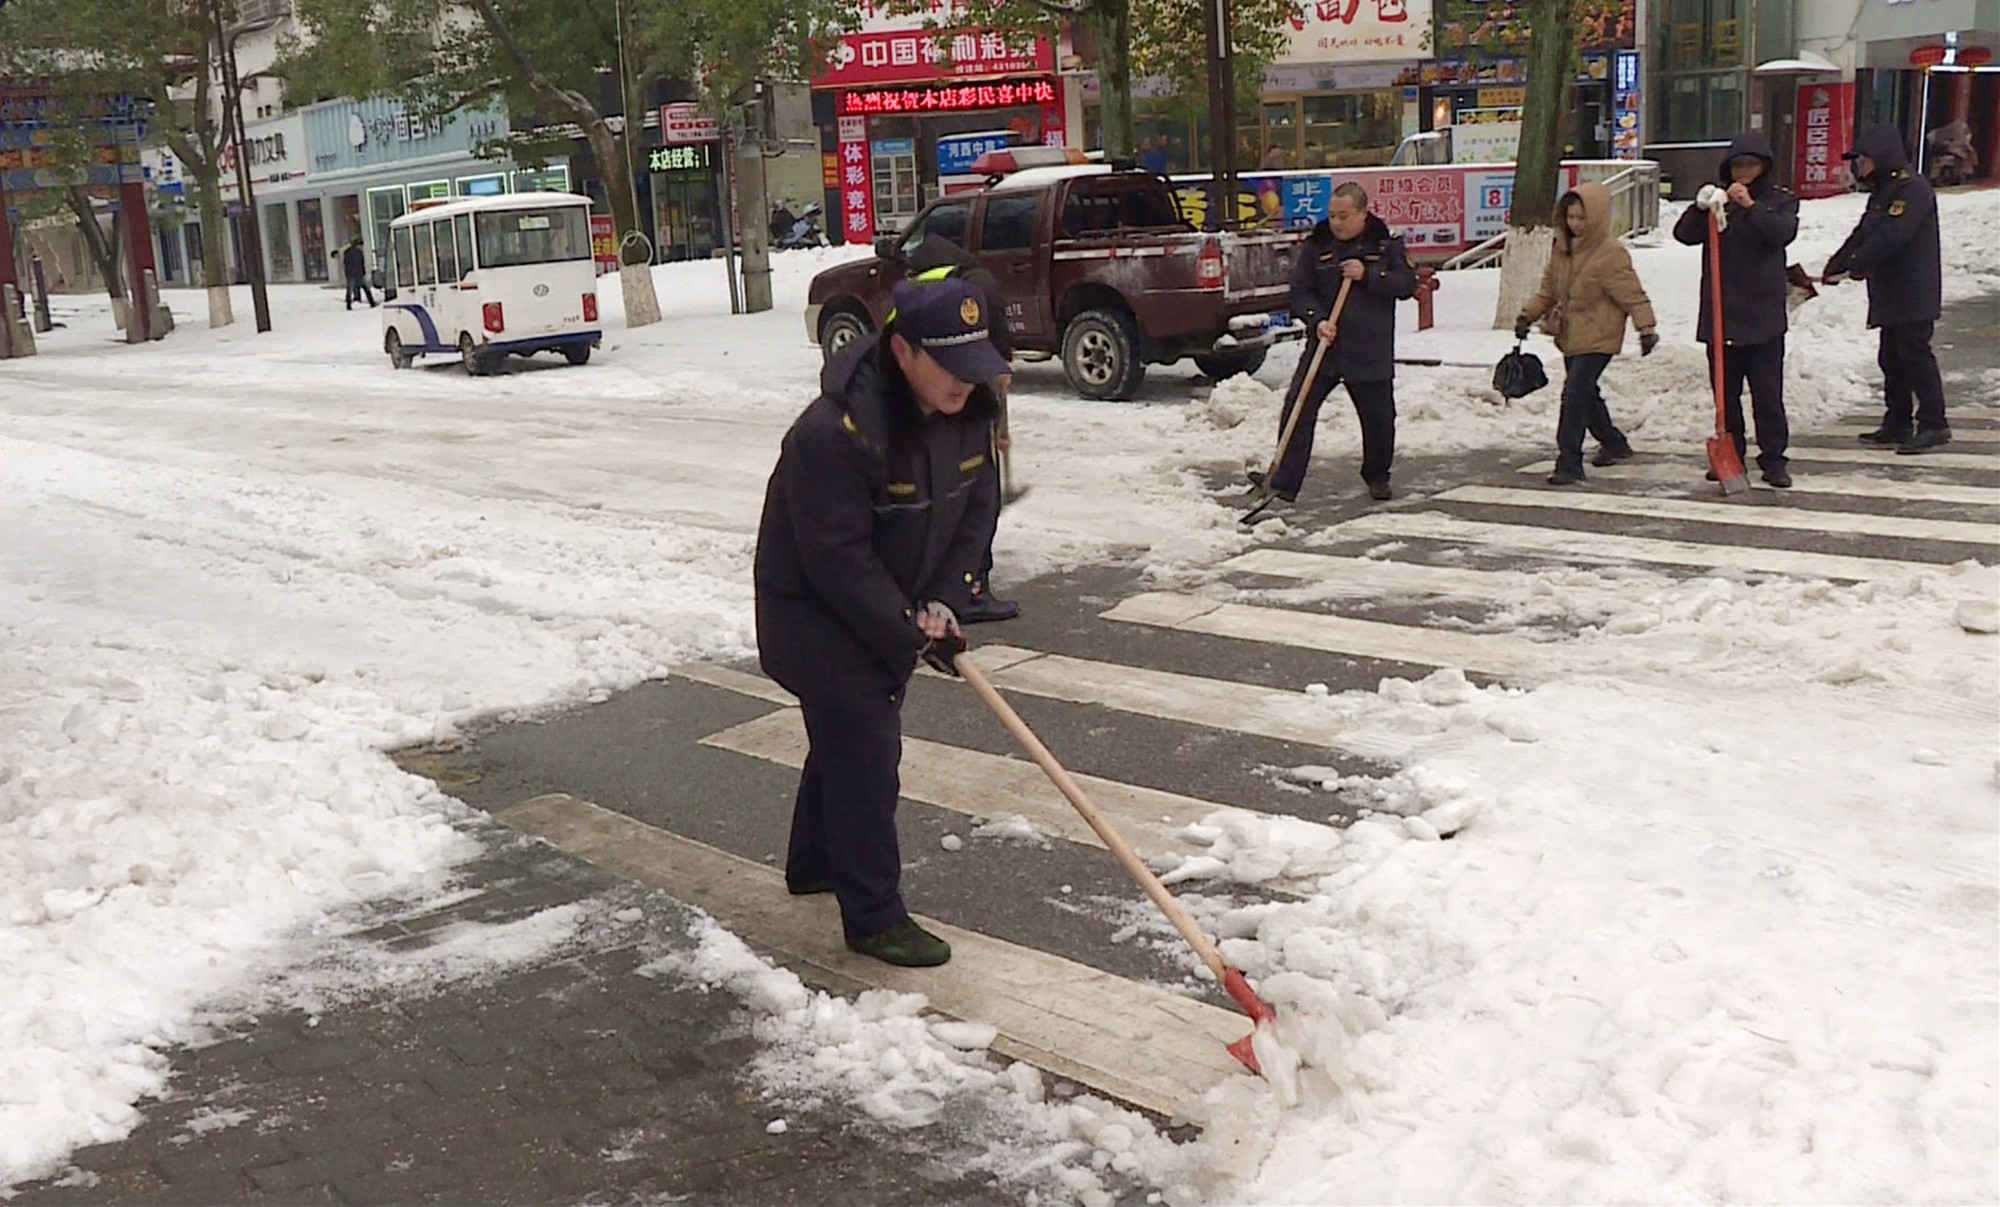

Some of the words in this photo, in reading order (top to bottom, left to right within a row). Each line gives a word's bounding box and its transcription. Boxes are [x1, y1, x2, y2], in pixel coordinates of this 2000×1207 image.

[845, 81, 1056, 112] 热烈祝贺本店彩民喜中快
[844, 142, 868, 232] 体彩竞彩
[1489, 189, 1501, 206] 8
